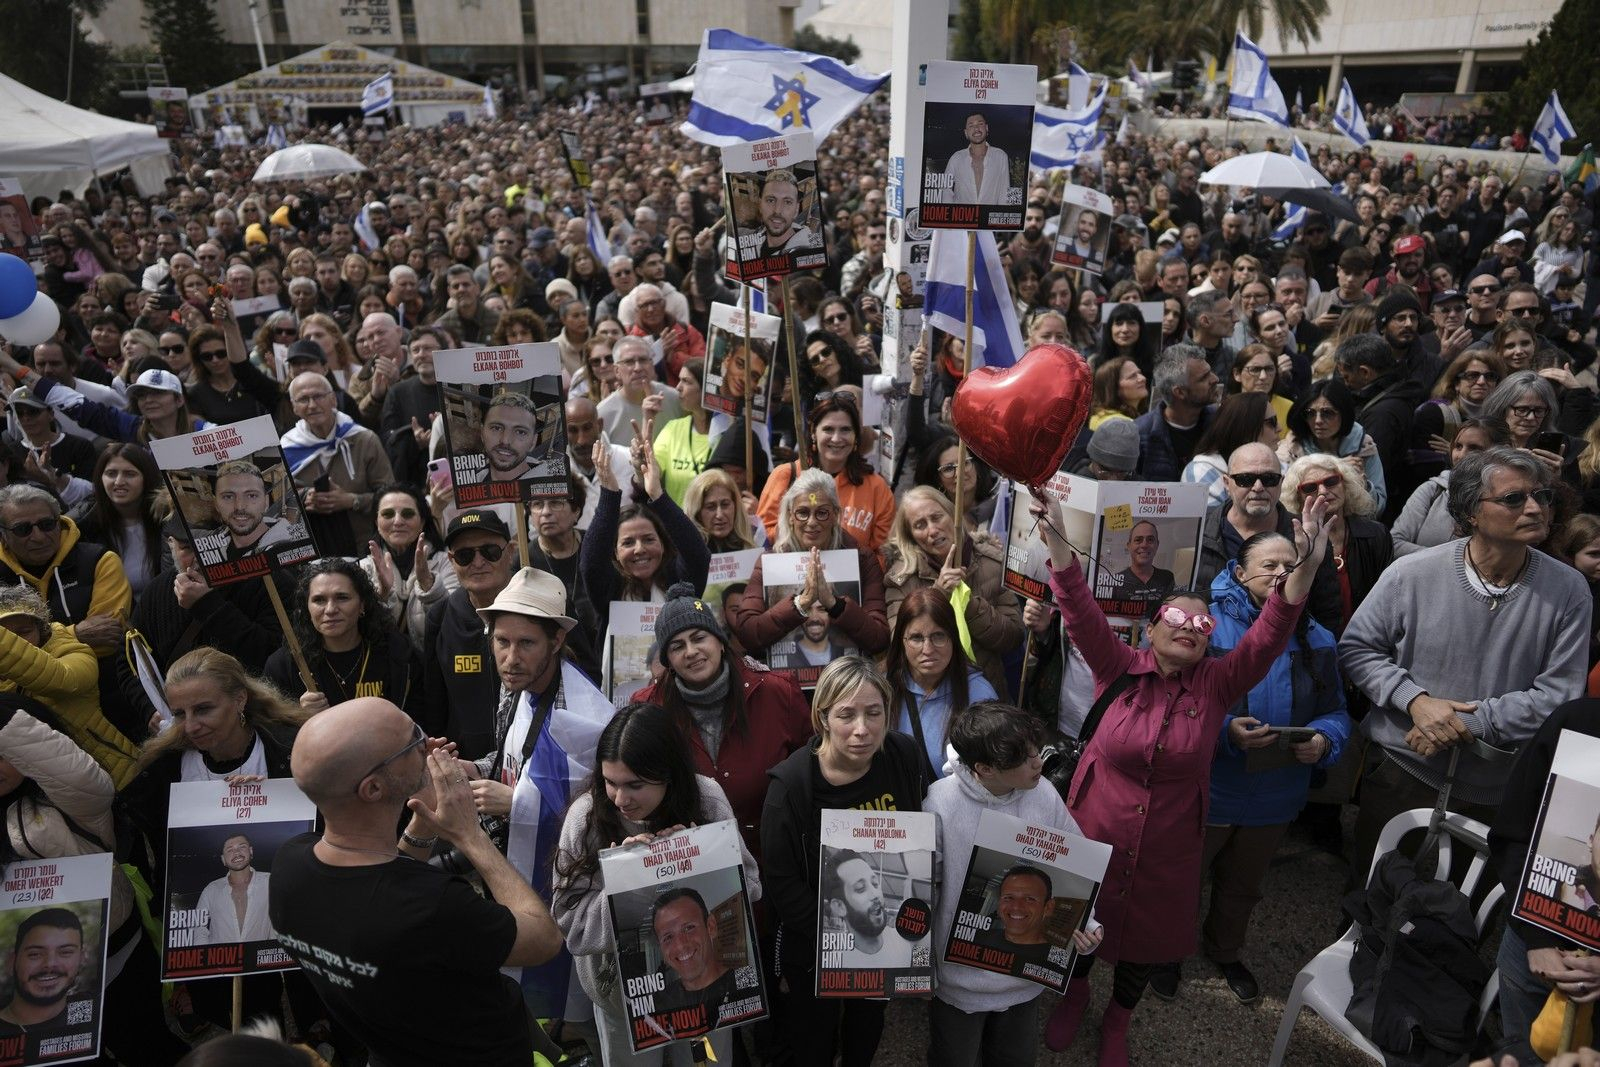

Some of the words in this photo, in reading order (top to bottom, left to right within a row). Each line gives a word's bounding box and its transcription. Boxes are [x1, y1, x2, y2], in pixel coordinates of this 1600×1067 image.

[980, 69, 994, 79] אליה
[964, 79, 980, 88] ELIYA
[981, 79, 998, 89] COHEN
[976, 89, 986, 99] (27)
[752, 152, 771, 161] ELKANA
[772, 148, 789, 158] BOHBOT
[924, 172, 954, 188] BRING
[924, 189, 942, 203] HIM
[923, 206, 949, 221] HOME
[952, 206, 979, 222] NOW!
[738, 234, 762, 248] BRING
[741, 248, 756, 261] HIM
[743, 260, 765, 274] HOME
[767, 256, 790, 269] NOW!
[476, 351, 498, 361] בוחבוט
[499, 349, 519, 359] אלקנה
[473, 362, 498, 372] ELKANA
[499, 359, 523, 370] BOHBOT
[494, 371, 507, 381] (34)
[216, 427, 237, 440] אלקנה
[192, 443, 218, 456] ELKANA
[218, 436, 244, 449] BOHBOT
[214, 452, 229, 462] (34)
[454, 454, 485, 470] BRING
[673, 458, 690, 470] לבד
[456, 470, 476, 486] HIM
[458, 485, 487, 501] HOME
[490, 481, 520, 497] NOW!
[1056, 484, 1071, 494] MIRAN
[1139, 505, 1156, 514] (50)
[462, 515, 480, 524] NOW.
[194, 533, 228, 552] BRING
[200, 550, 222, 566] HIM
[1009, 545, 1028, 563] BRING
[207, 563, 236, 580] HOME
[238, 554, 268, 572] NOW!
[1008, 557, 1019, 572] HIM
[1007, 570, 1023, 587] HOME
[1023, 578, 1045, 597] NOW!
[1097, 573, 1124, 586] BRING
[1096, 586, 1113, 598] HIM
[1120, 601, 1147, 614] NOW!
[771, 642, 796, 654] BRING
[456, 657, 479, 671] SOS
[772, 655, 788, 668] HIM
[229, 784, 242, 797] כהן
[243, 785, 261, 795] אליה
[222, 797, 242, 808] ELIYA
[244, 795, 267, 807] COHEN
[236, 807, 251, 818] (27)
[885, 818, 896, 828] חנן
[853, 828, 877, 838] CHANAN
[878, 829, 906, 839] YABLONKA
[1026, 826, 1047, 839] יהלומי
[1049, 833, 1065, 844] אוהד
[674, 836, 690, 847] אוהד
[874, 839, 886, 850] (42)
[1015, 833, 1035, 846] OHAD
[1036, 840, 1069, 856] YAHALOMI
[643, 853, 664, 868] OHAD
[664, 846, 700, 864] YAHALOMI
[1022, 846, 1042, 858] (50)
[14, 866, 36, 879] ונקרט
[39, 864, 56, 875] עומר
[656, 866, 676, 879] (50)
[1532, 854, 1577, 886] BRING
[5, 879, 26, 892] OMER
[28, 875, 64, 889] WENKERT
[1527, 872, 1557, 898] HIM
[12, 892, 36, 905] (23)
[904, 906, 925, 921] הושב
[1523, 891, 1565, 922] HOME
[170, 909, 210, 929] BRING
[898, 917, 926, 934] לקבורה
[959, 910, 992, 931] BRING
[169, 929, 193, 948] HIM
[954, 925, 976, 942] HIM
[822, 933, 854, 951] BRING
[168, 947, 203, 969] HOME
[208, 945, 243, 966] NOW!
[257, 954, 282, 965] FAMILIES
[312, 945, 344, 968] מקום
[822, 951, 843, 968] HIM
[951, 941, 982, 960] HOME
[983, 949, 1015, 968] NOW!
[345, 956, 378, 977] לכל
[627, 972, 665, 998] BRING
[821, 971, 851, 989] HOME
[854, 970, 884, 989] NOW!
[895, 982, 914, 991] FAMILIES
[915, 982, 930, 990] FORUM
[631, 997, 655, 1018] HIM
[719, 1007, 742, 1021] FAMILIES
[743, 1001, 762, 1014] FORUM
[635, 1014, 671, 1041] HOME
[672, 1001, 707, 1031] NOW!
[39, 1042, 68, 1056] FAMILIES
[69, 1038, 92, 1050] FORUM
